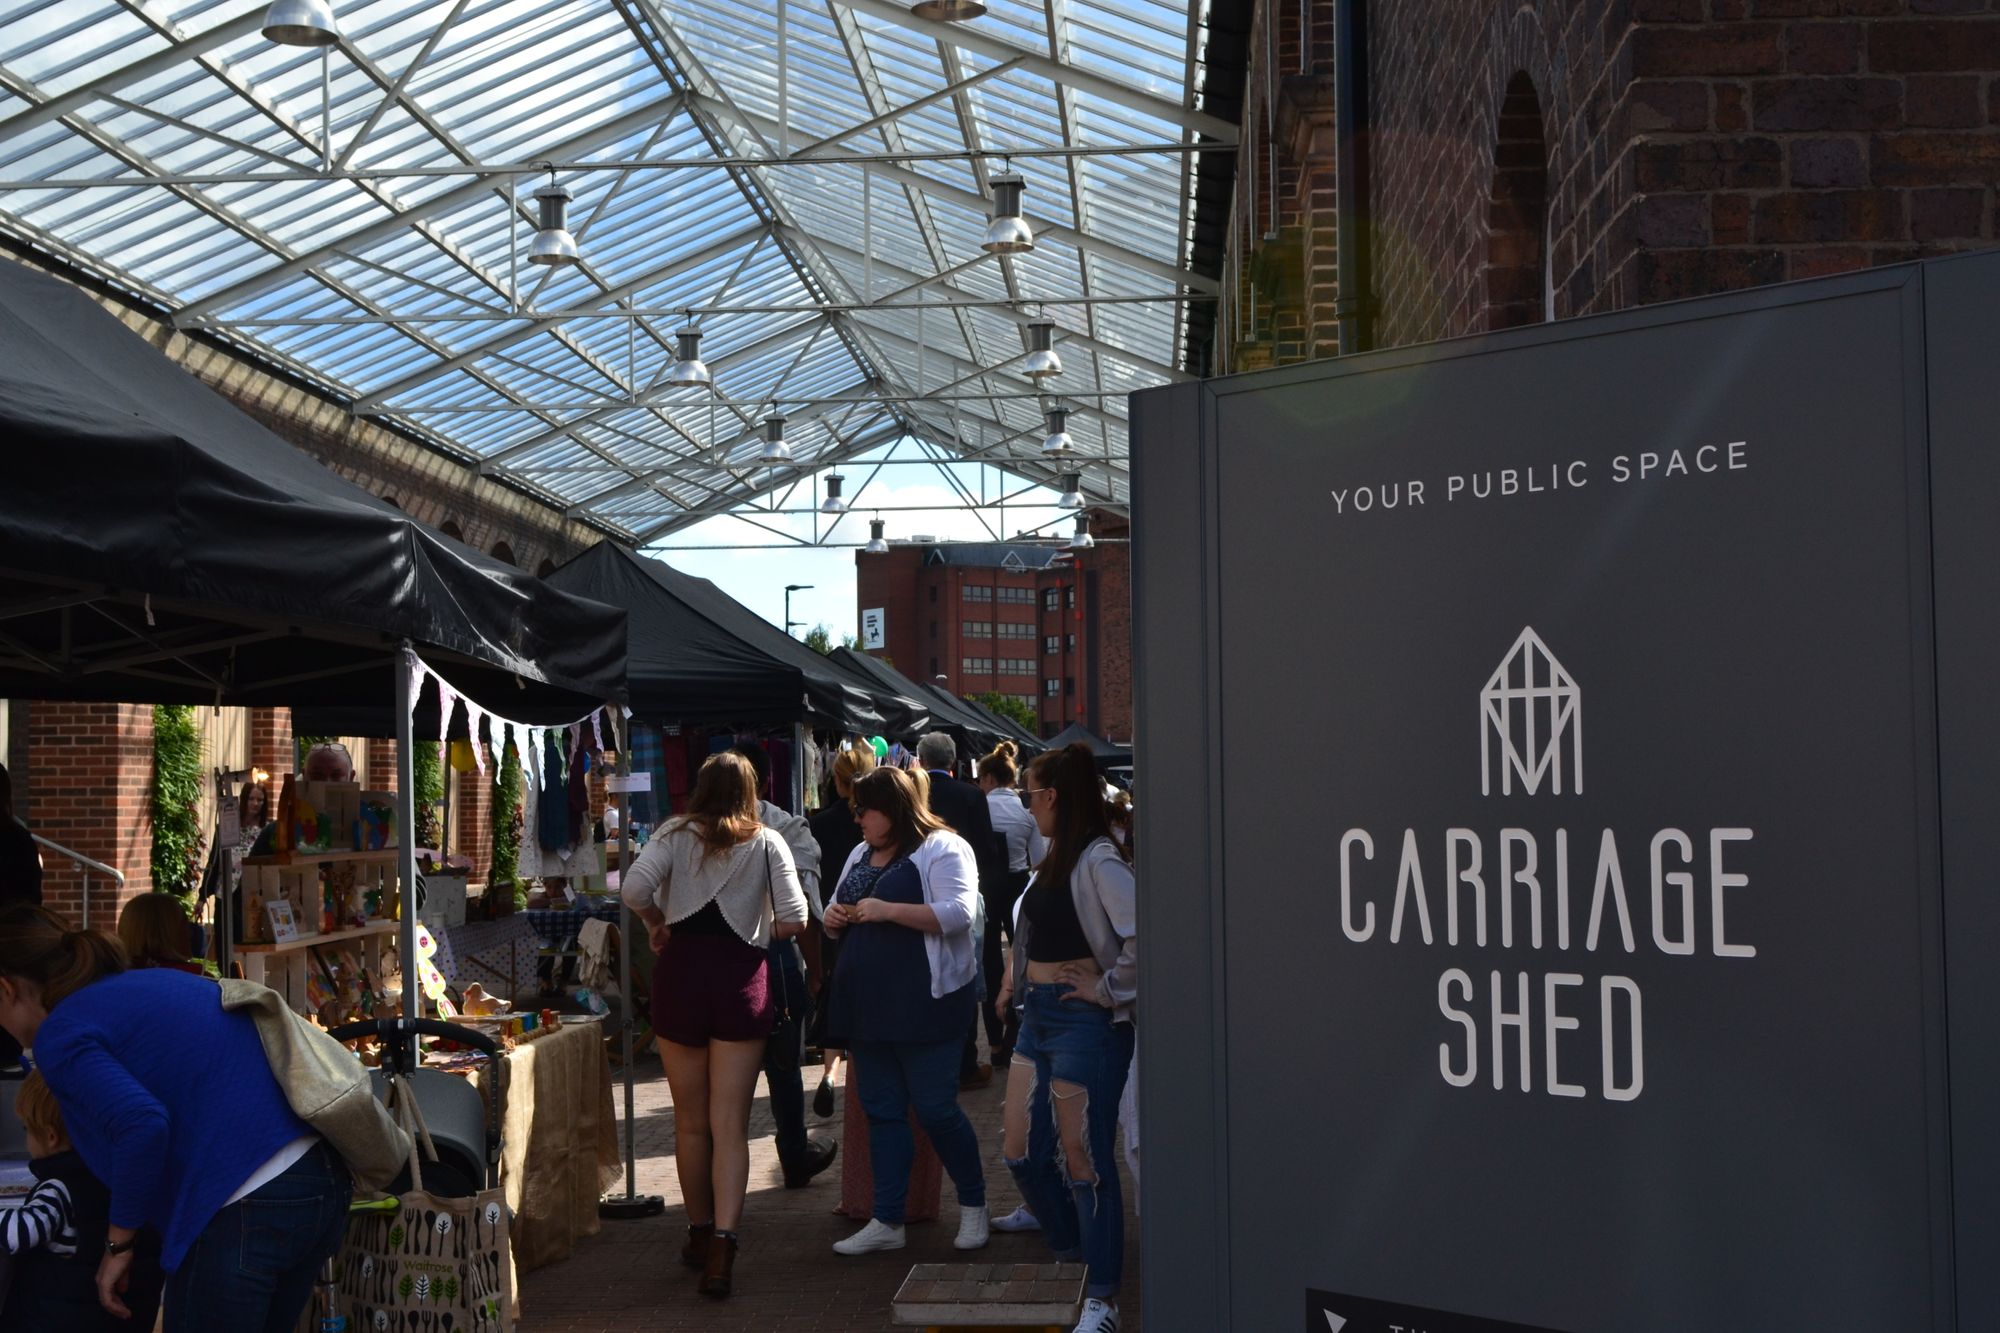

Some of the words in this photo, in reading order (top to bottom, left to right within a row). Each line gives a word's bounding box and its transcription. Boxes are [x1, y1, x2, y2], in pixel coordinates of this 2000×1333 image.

[1331, 480, 1425, 514] YOUR
[1447, 460, 1588, 502] PUBLIC
[1612, 441, 1748, 483] SPACE
[1339, 827, 1757, 958] CARRIAGE
[1437, 967, 1644, 1102] SHED
[404, 1260, 453, 1273] Waitrose
